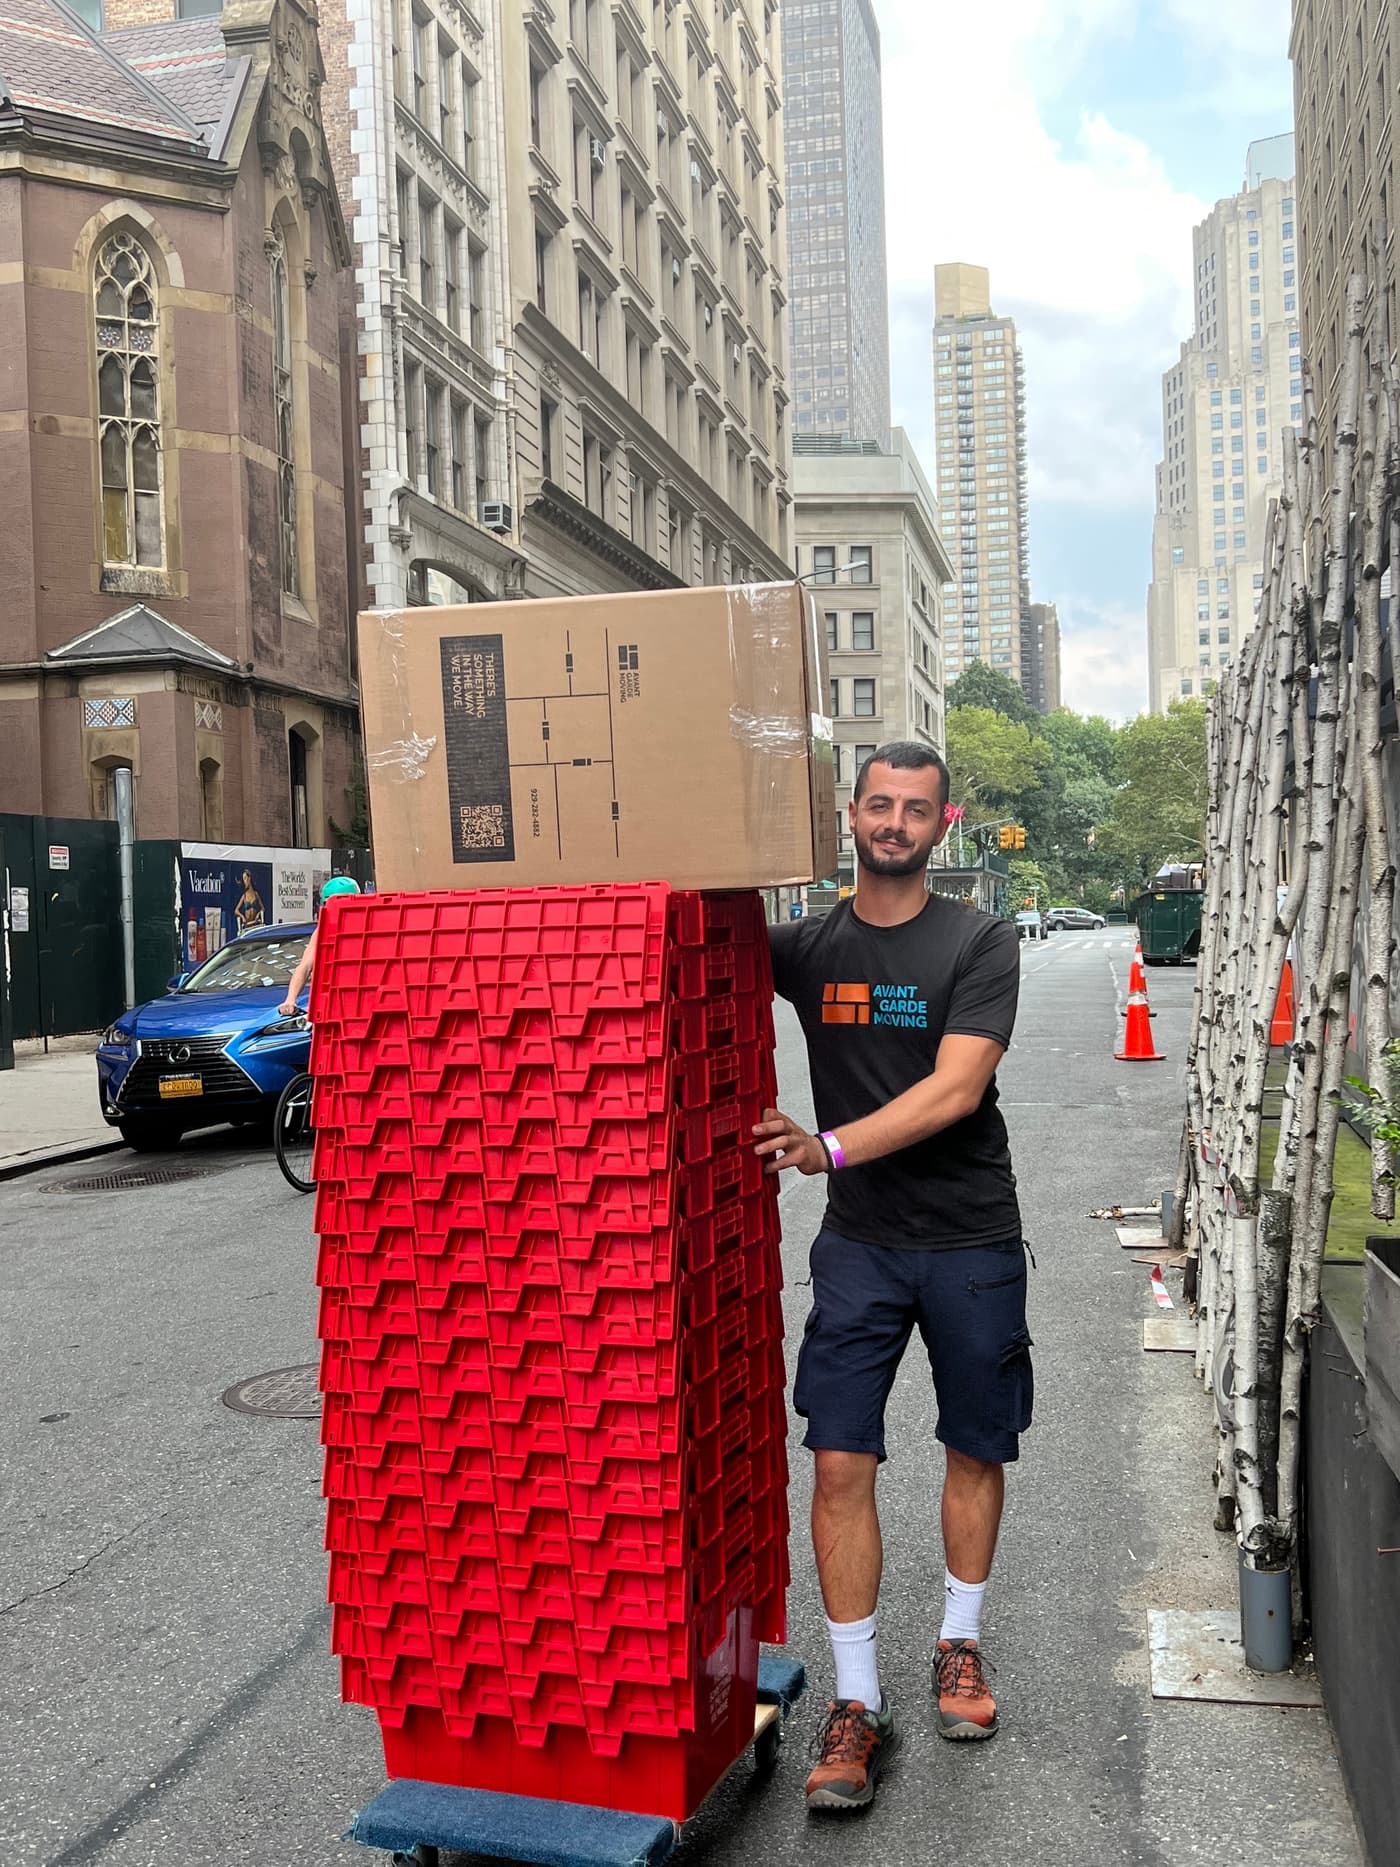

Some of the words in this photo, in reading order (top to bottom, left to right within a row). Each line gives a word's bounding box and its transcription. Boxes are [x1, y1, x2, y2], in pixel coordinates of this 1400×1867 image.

[451, 655, 461, 673] WE
[462, 654, 471, 666] IN
[463, 668, 473, 689] THE
[485, 652, 496, 697] THERE'S
[473, 653, 486, 719] SOMETHING
[619, 672, 627, 703] MOVING
[464, 691, 474, 716] WAY
[872, 984, 919, 999] AVANT
[879, 999, 928, 1014] GARDE
[873, 1011, 928, 1028] MOVING
